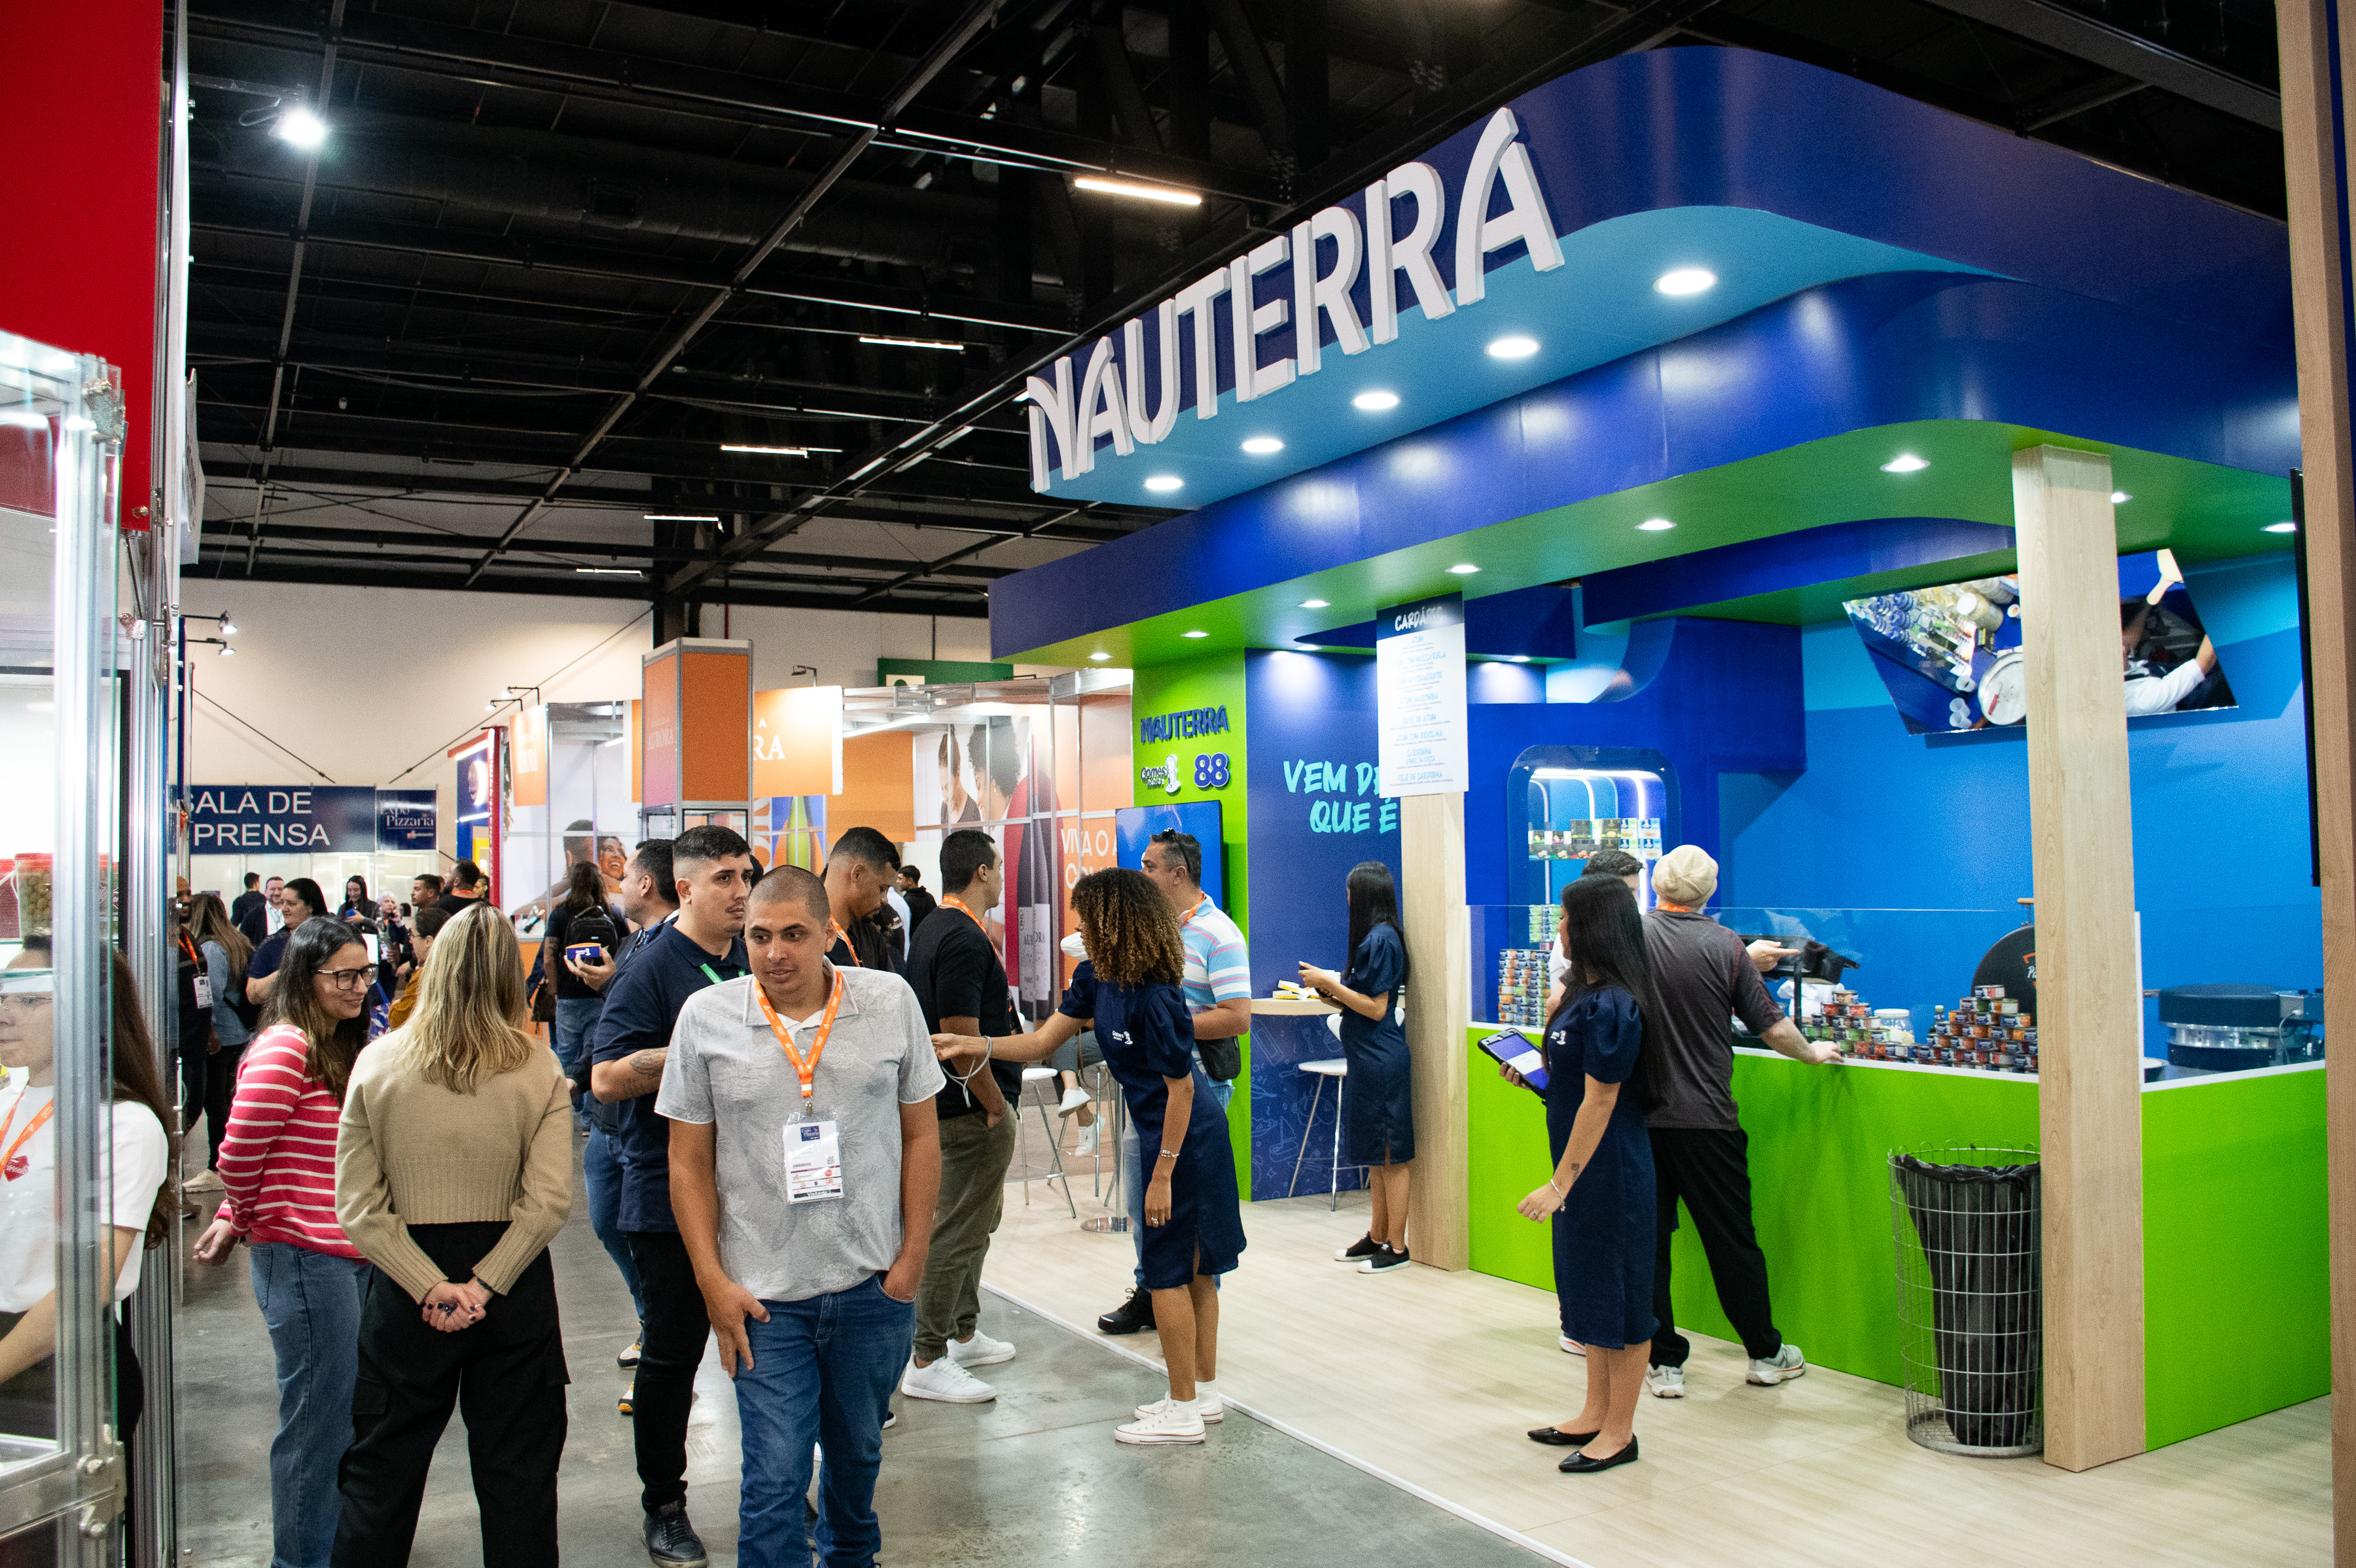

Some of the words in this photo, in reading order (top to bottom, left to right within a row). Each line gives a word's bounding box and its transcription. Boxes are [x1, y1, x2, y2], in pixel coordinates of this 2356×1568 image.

[1027, 107, 1565, 493] NAUTERRA
[1141, 705, 1230, 743] NAUTERRA
[1141, 767, 1166, 779] Gomes
[1194, 753, 1230, 788] 88
[1283, 758, 1348, 794] VEM
[269, 792, 312, 814] DE
[1310, 800, 1371, 834] QUE
[386, 814, 434, 827] Pizzaria
[1061, 828, 1092, 857] VIVA
[1096, 829, 1109, 857] O
